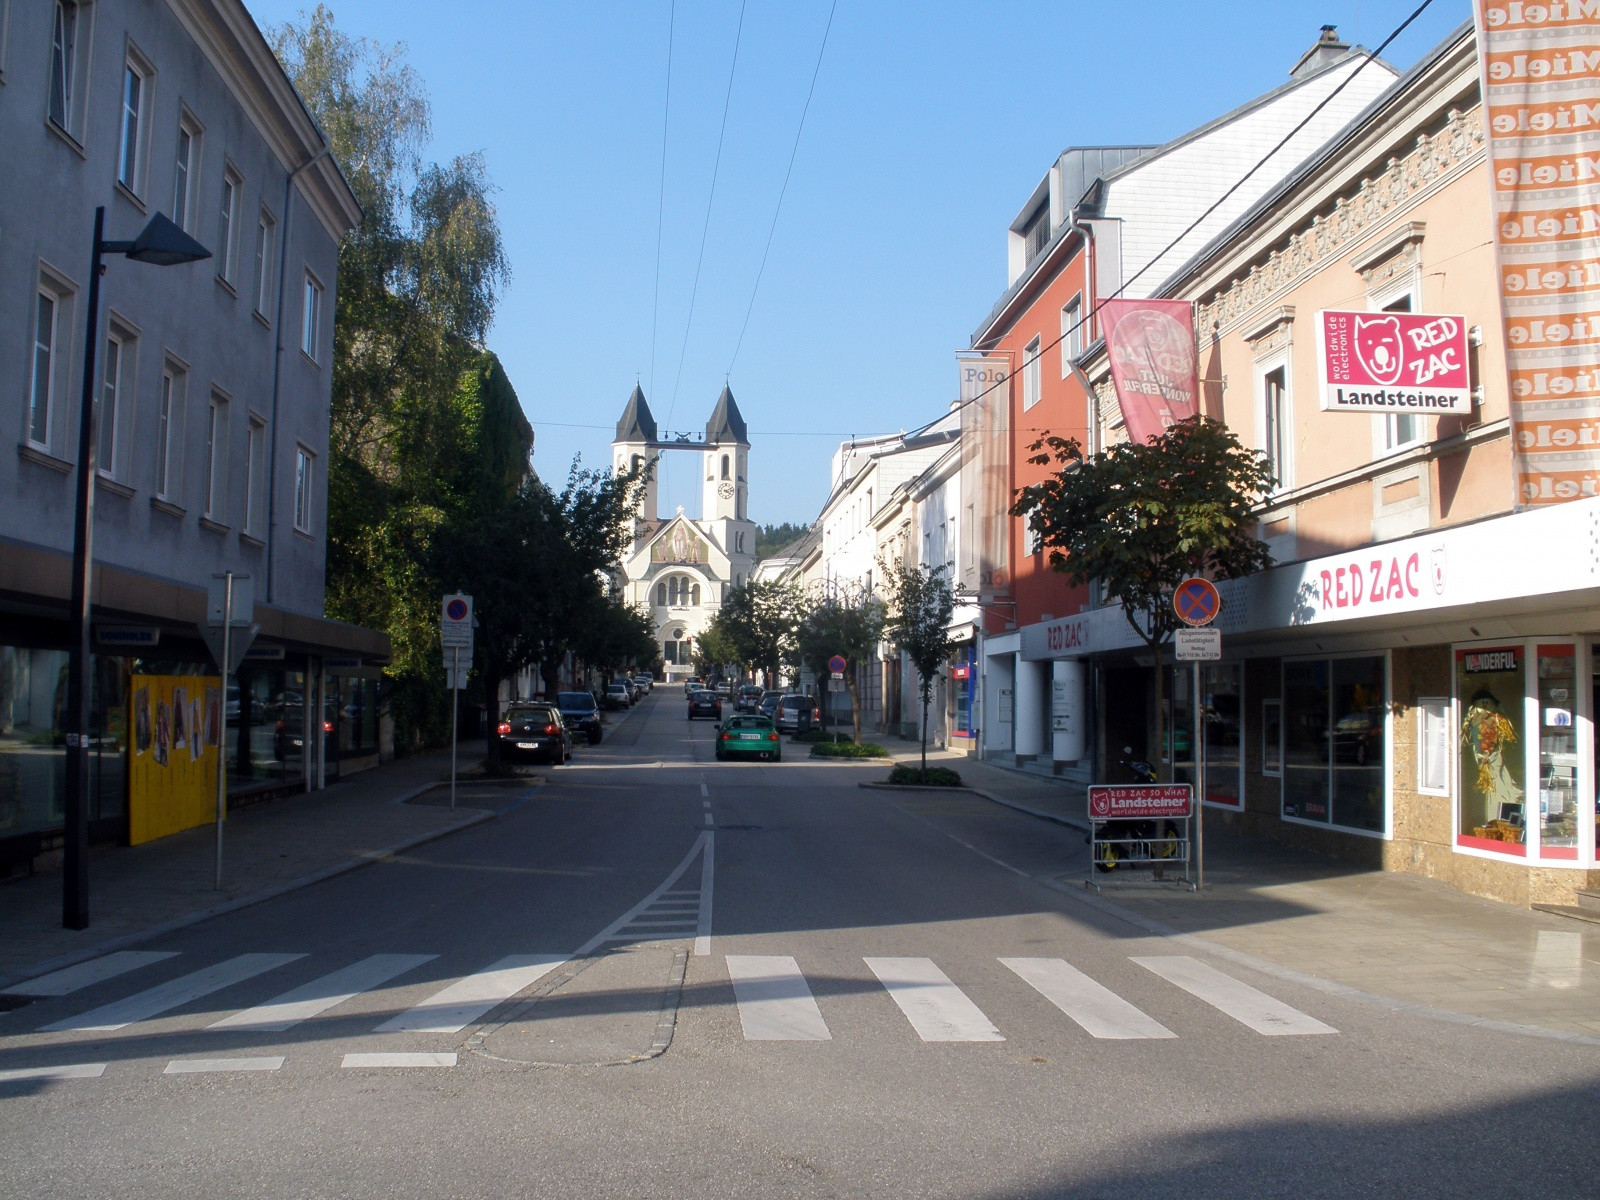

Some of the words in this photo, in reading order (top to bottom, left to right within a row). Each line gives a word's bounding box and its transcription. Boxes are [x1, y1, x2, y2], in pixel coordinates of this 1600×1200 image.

[1328, 316, 1341, 380] worldwide
[1337, 316, 1350, 381] electronics
[1407, 317, 1458, 351] RED
[964, 368, 1005, 383] Polo
[1408, 348, 1461, 385] ZAC
[1337, 388, 1459, 408] Landsteiner
[1320, 562, 1364, 610] RED
[1370, 552, 1420, 602] ZAC
[1183, 614, 1211, 624] ANFANG
[1047, 624, 1063, 650] RED
[1065, 621, 1082, 649] ZAC
[1111, 797, 1186, 808] Landsteiner
[1130, 789, 1146, 797] ZAC
[1164, 788, 1187, 796] WHAT
